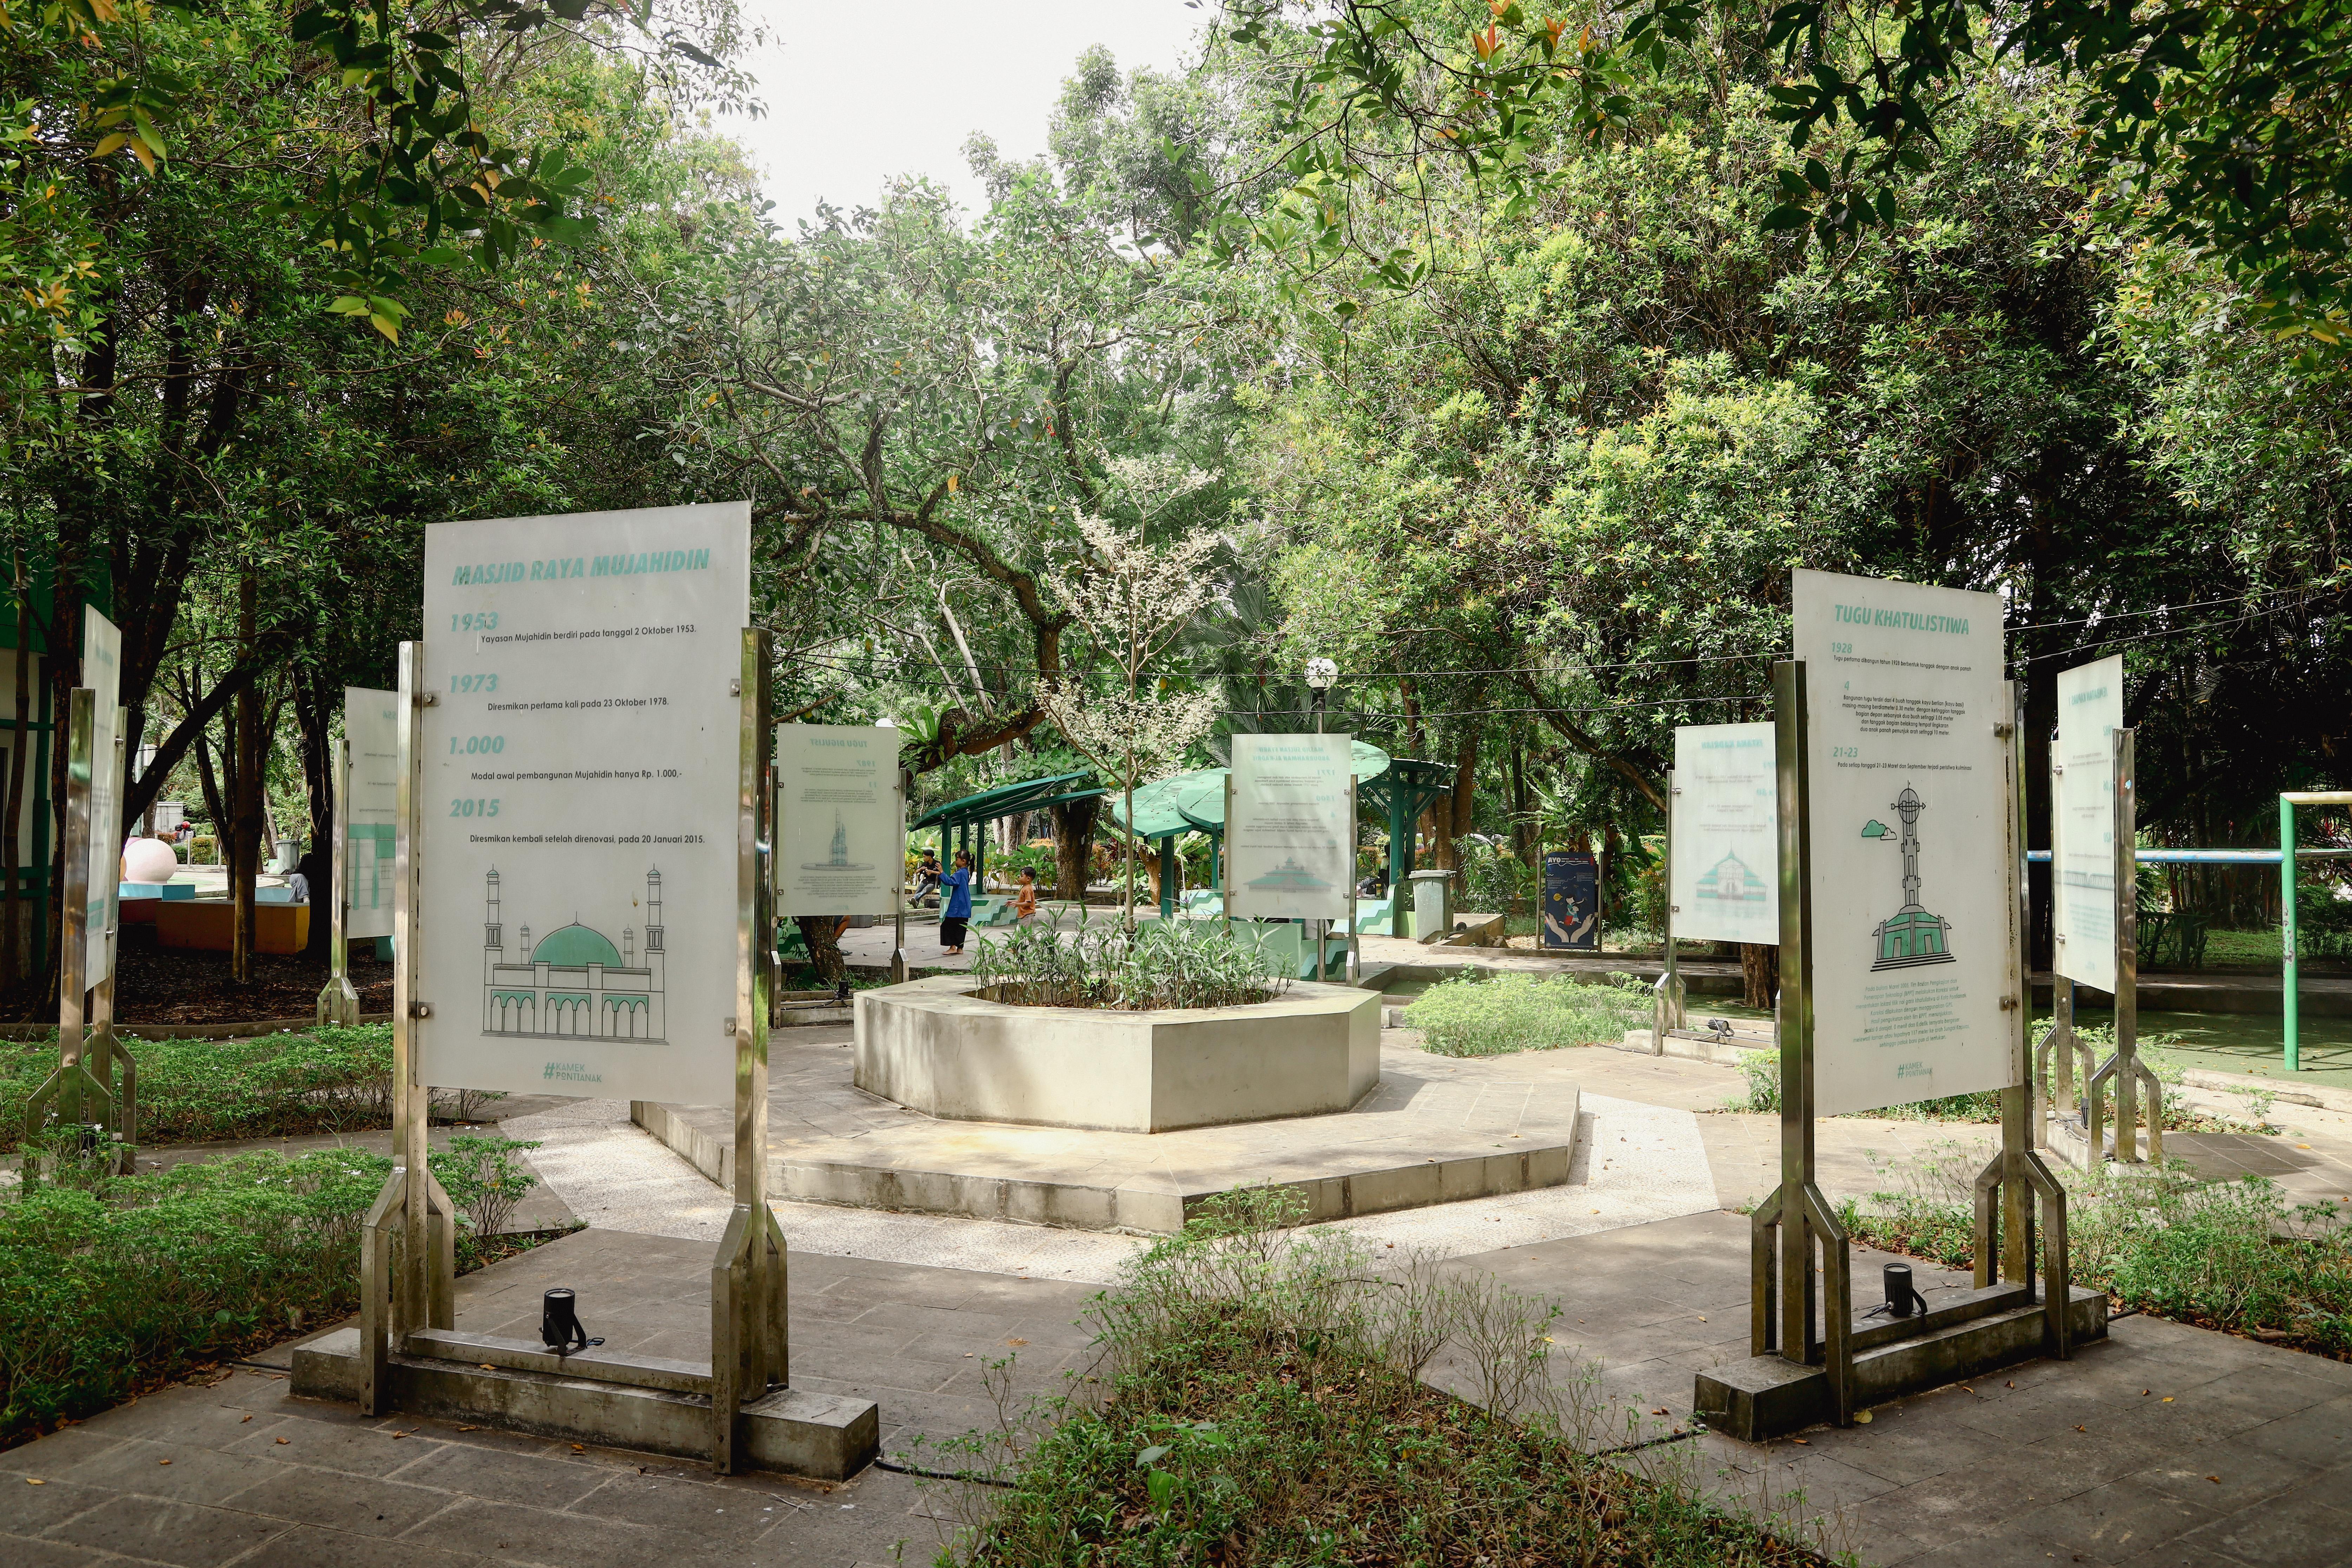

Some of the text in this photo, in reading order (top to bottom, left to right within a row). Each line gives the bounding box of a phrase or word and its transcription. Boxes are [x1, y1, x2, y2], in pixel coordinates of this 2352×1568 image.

[451, 548, 710, 585] MASJID RAYA MUJAHIDIN
[451, 611, 498, 632] 1953
[1835, 604, 1969, 635] TUGU KHATULISTIWA
[481, 635, 513, 644] Yayasan
[515, 632, 551, 643] Mujahidin
[554, 630, 577, 639] berdiri
[580, 630, 600, 640] pada
[602, 627, 632, 638] tanggal
[641, 626, 673, 635] Oktober
[677, 624, 696, 633] 1953.
[1832, 642, 1852, 654] 1928
[450, 673, 499, 693] 1973
[1844, 681, 1849, 691] 4
[488, 697, 669, 711] Diresmikan pertama kali pada 23 Oktober 1978.
[450, 735, 505, 755] 1.000
[1833, 746, 1858, 757] 21-23
[516, 771, 572, 781] pembangunan
[575, 770, 612, 780] Mujahidin
[614, 770, 639, 779] hanya
[642, 770, 653, 779] Rp.
[657, 769, 682, 778] 1.000,-
[449, 799, 500, 817] 2015
[513, 834, 542, 842] kembali
[545, 834, 572, 842] setelah
[574, 835, 615, 844] direnovasi,
[618, 835, 639, 845] pada
[641, 835, 651, 843] 20
[653, 835, 682, 843] Januari
[684, 835, 705, 843] 2015.
[556, 1072, 602, 1082] PONTIANAK
[1906, 1068, 1933, 1077] PONTIANAK
